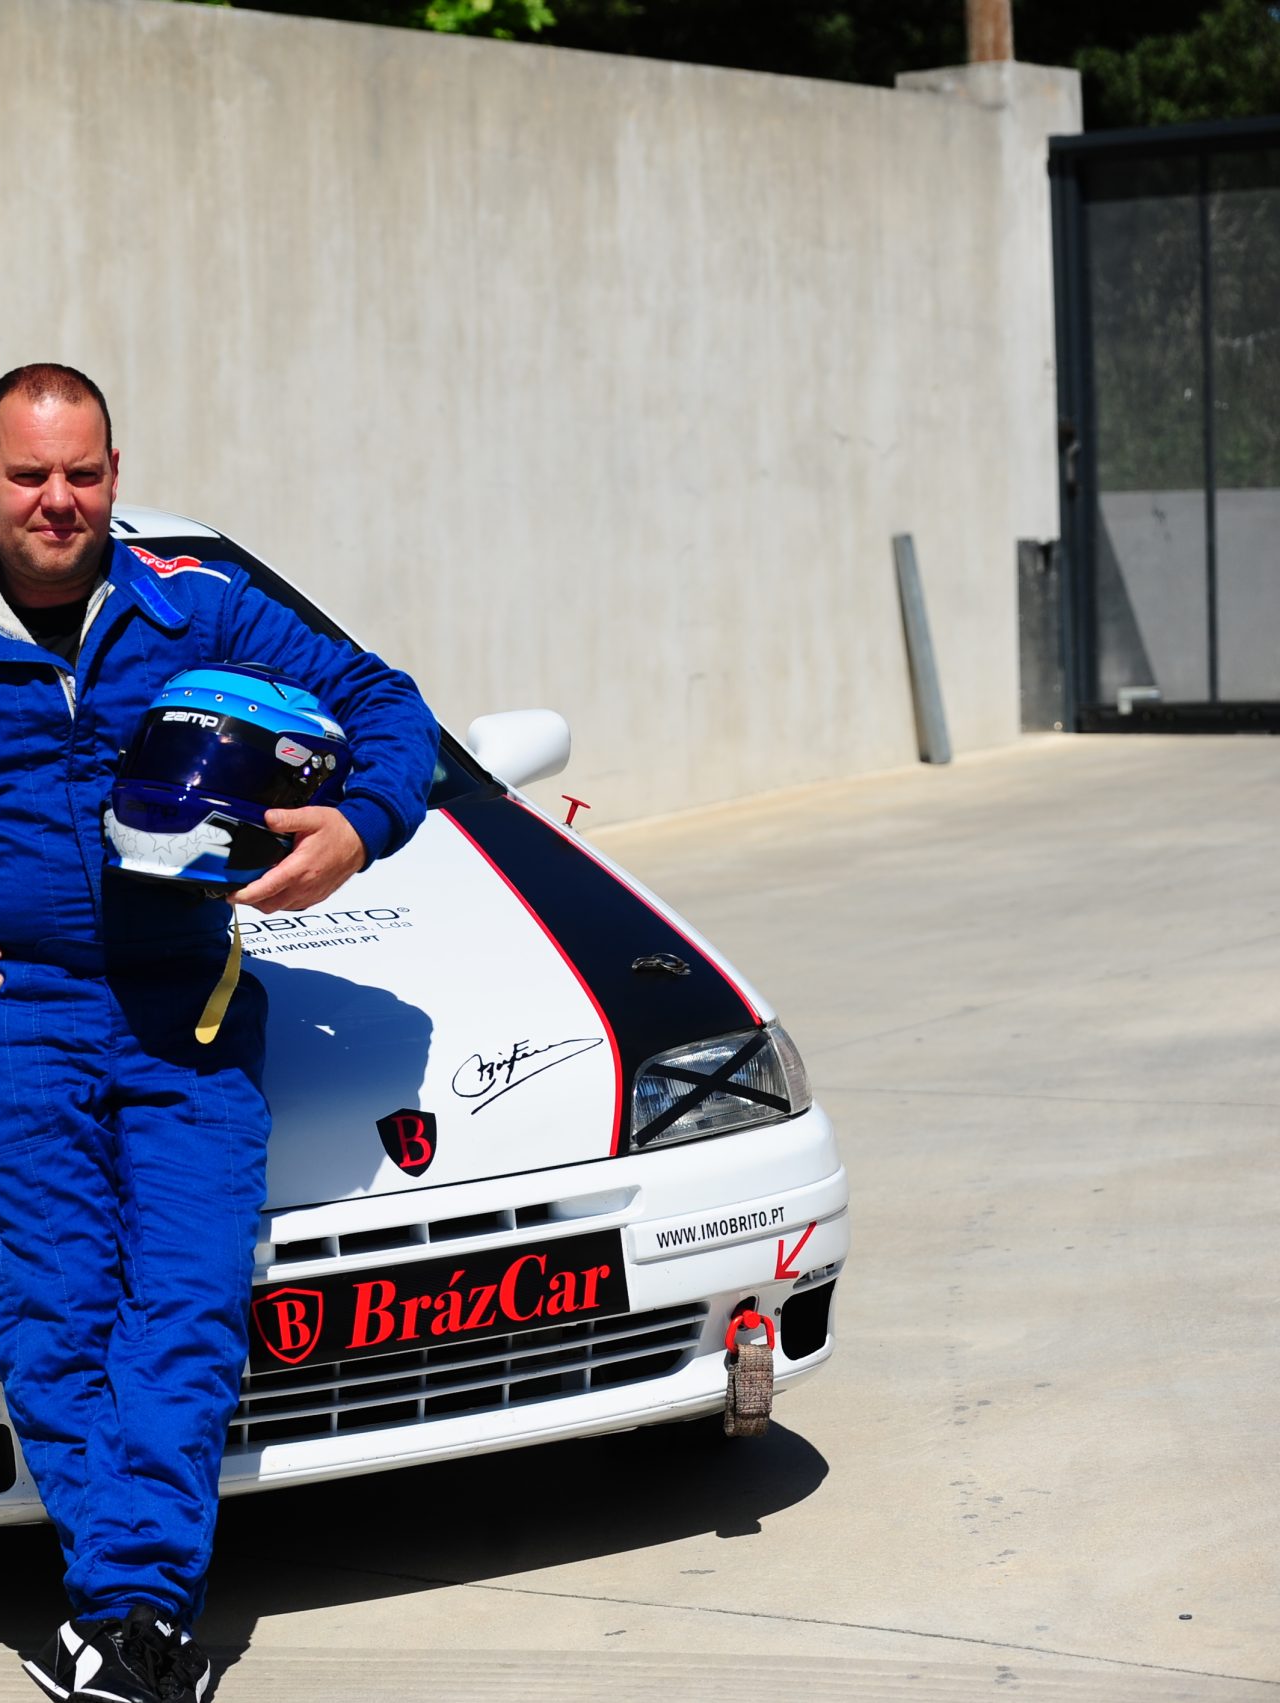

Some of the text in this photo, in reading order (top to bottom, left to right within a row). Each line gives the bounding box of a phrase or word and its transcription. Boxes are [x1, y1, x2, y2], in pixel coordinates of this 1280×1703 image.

[162, 710, 219, 728] zamp
[242, 934, 380, 957] WW.IMOBRITO.PT
[392, 1115, 432, 1168] B
[656, 1206, 786, 1250] WWW.IMOBRITO.PT
[345, 1254, 612, 1350] BrázCar
